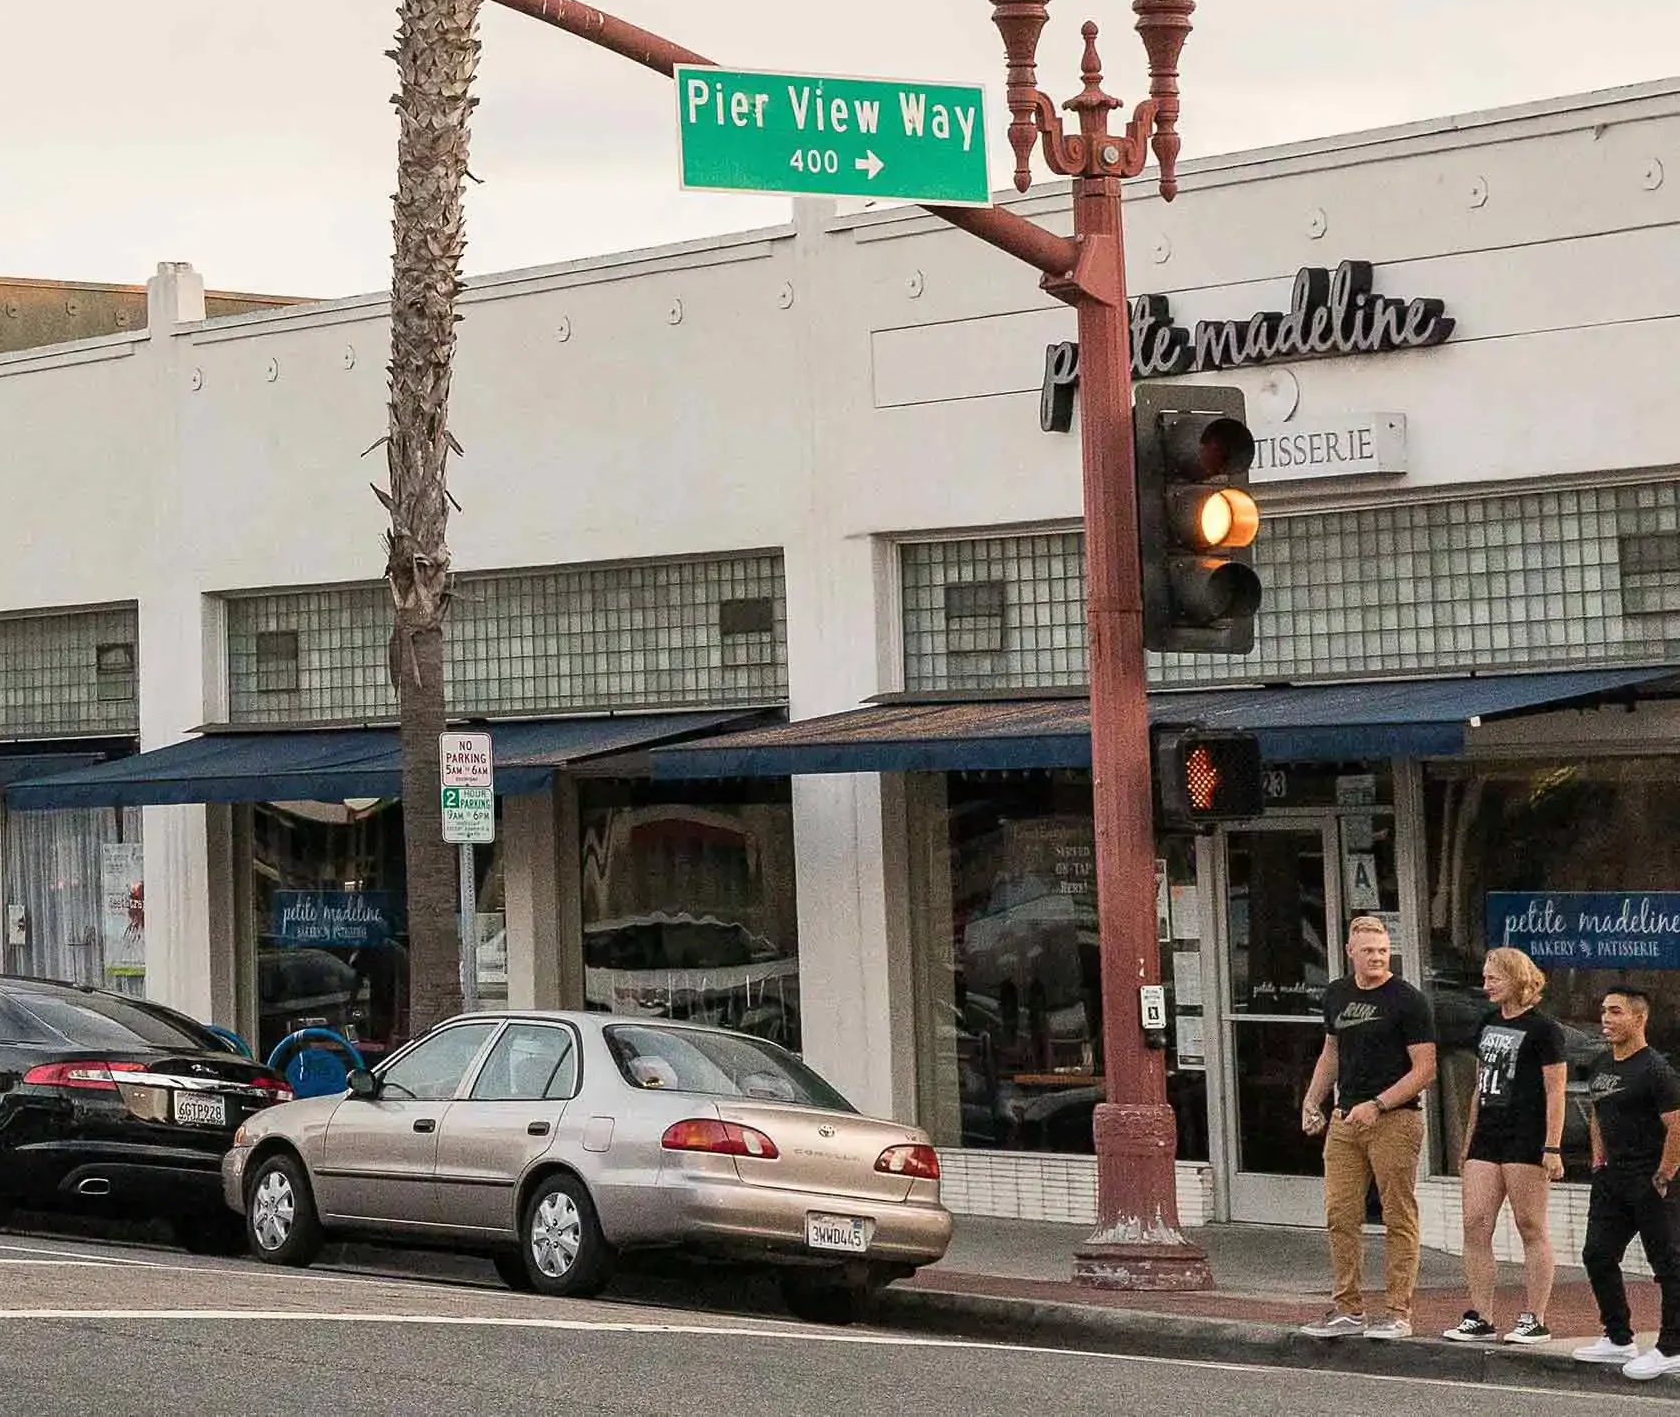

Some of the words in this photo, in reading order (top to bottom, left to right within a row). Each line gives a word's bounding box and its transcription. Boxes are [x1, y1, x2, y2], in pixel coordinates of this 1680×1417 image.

[687, 78, 770, 130] Pier
[787, 84, 880, 135] View
[898, 91, 977, 152] Way
[790, 148, 839, 175] 400
[1194, 259, 1456, 372] madeline
[1249, 428, 1374, 470] TISSERIE
[459, 740, 472, 751] NO
[446, 753, 487, 764] PARKING
[446, 764, 463, 775] 5AM
[471, 764, 488, 775] 6AM
[446, 790, 457, 806] 2
[464, 789, 487, 798] HOUR
[460, 799, 490, 809] PARKING
[1355, 861, 1371, 889] A
[282, 893, 317, 935] petite
[1503, 899, 1567, 948] petite
[1578, 897, 1680, 934] madeline
[1530, 940, 1576, 956] BAKERY
[1597, 940, 1660, 957] PATISSERIE
[179, 1101, 222, 1120] 6GTP928
